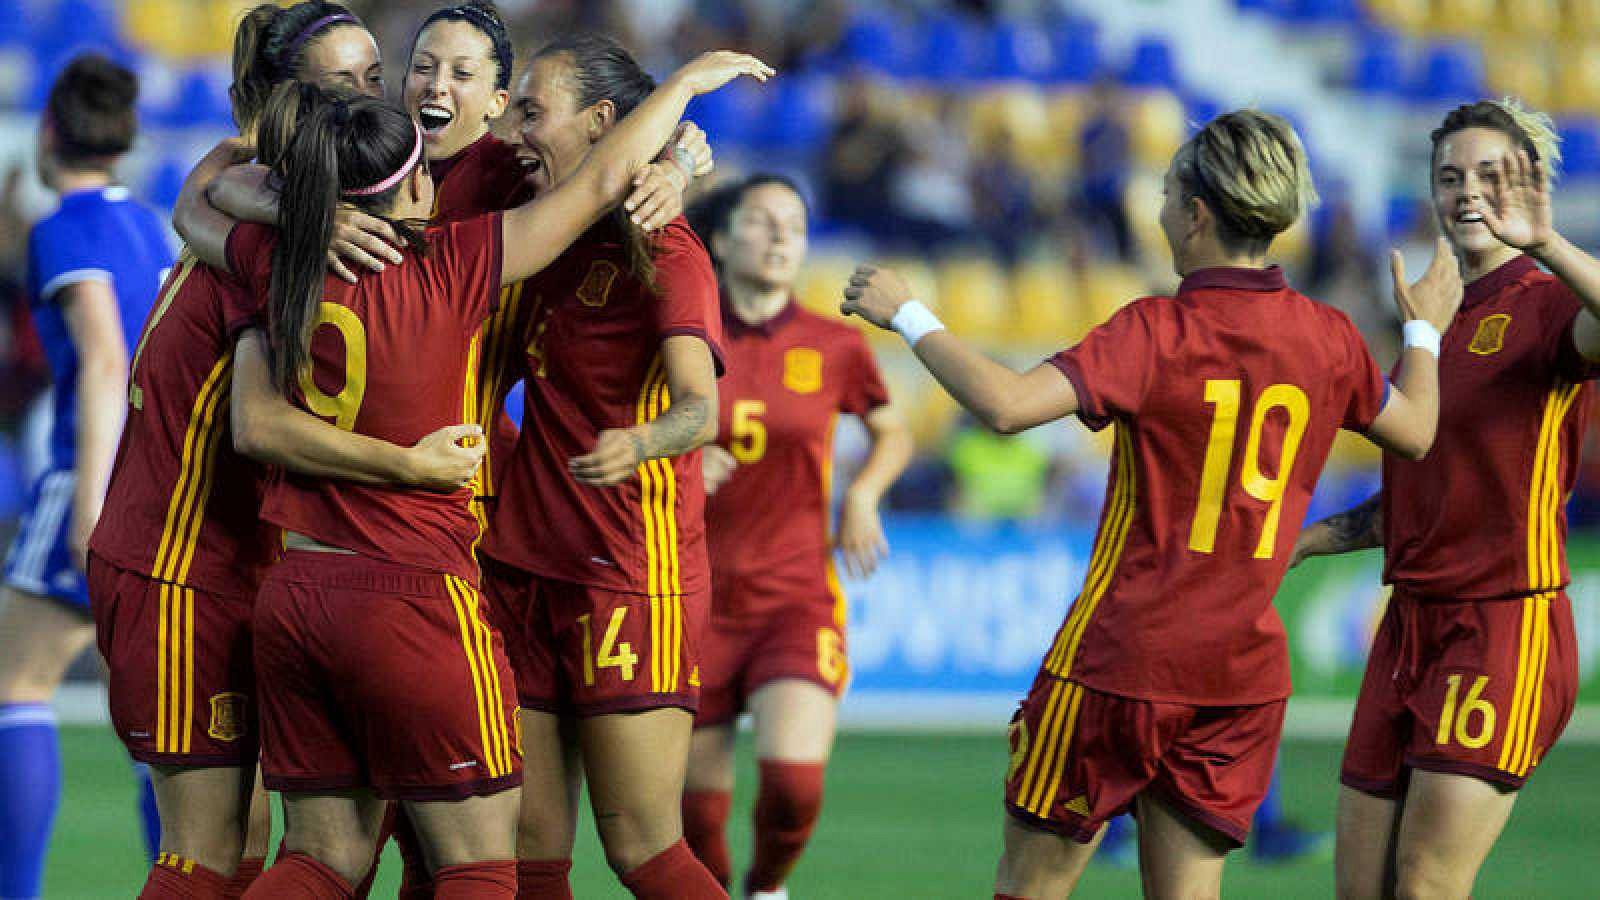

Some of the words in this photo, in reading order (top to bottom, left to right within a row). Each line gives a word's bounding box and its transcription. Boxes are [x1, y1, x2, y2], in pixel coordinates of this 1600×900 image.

[298, 302, 367, 432] 9
[731, 401, 767, 463] 5
[1189, 379, 1311, 560] 19
[576, 607, 638, 686] 14
[1436, 674, 1496, 749] 16
